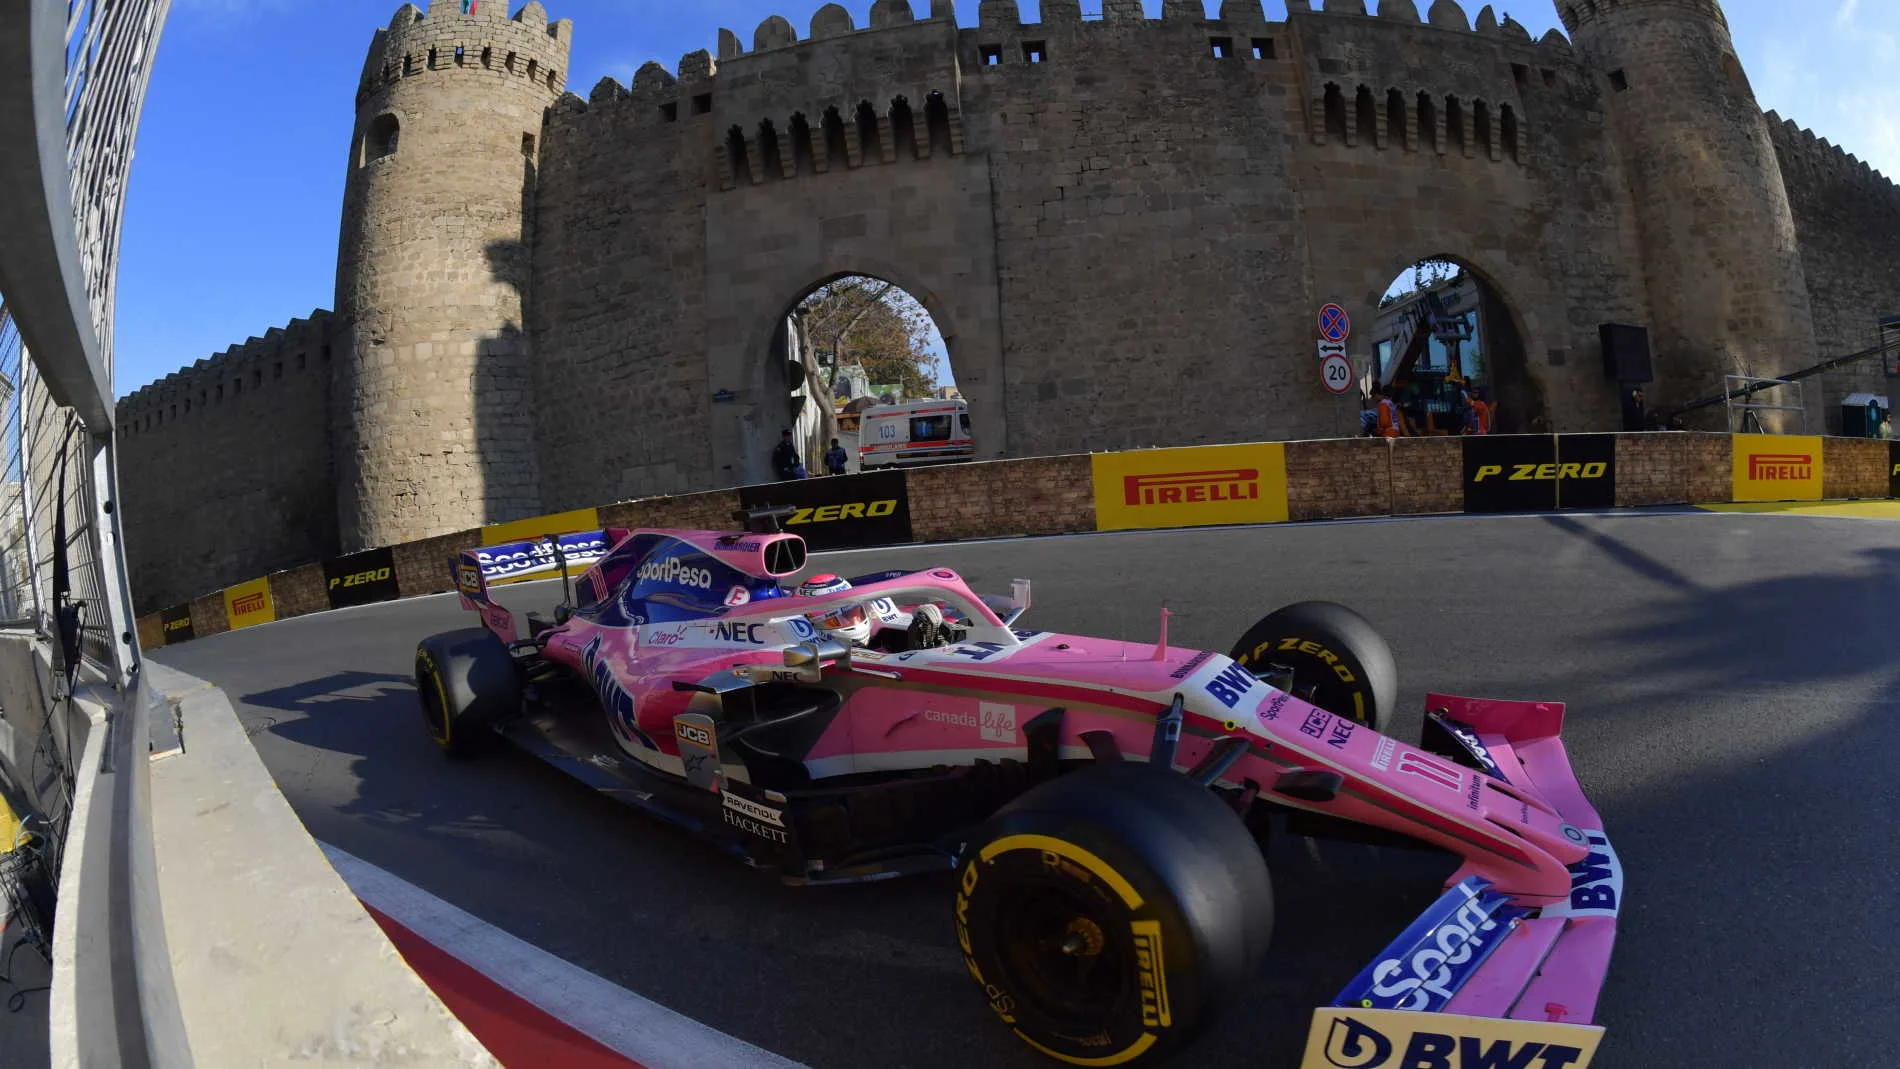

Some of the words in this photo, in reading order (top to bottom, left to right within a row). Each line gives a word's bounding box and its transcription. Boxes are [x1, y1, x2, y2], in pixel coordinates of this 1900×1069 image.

[1329, 365, 1347, 381] 20
[880, 425, 895, 438] 103
[1473, 465, 1503, 482] P
[1508, 462, 1607, 480] ZERO
[1749, 454, 1811, 480] PIRELLI
[1124, 469, 1259, 505] PIRELLI
[785, 500, 897, 525] ZERO
[329, 578, 340, 590] P
[344, 567, 390, 587] ZERO
[232, 592, 264, 616] PIRELLI
[169, 618, 190, 630] ZERO
[715, 621, 764, 644] NEC
[649, 631, 678, 646] Claro
[1278, 638, 1355, 682] ZERO
[772, 670, 800, 681] NEC
[1205, 661, 1258, 709] BWT
[679, 726, 710, 745] JCB
[925, 710, 977, 727] canada
[979, 711, 1016, 737] life
[1327, 719, 1355, 749] NEC
[1397, 750, 1464, 793] 11
[726, 797, 777, 821] RAVENOL
[723, 809, 788, 844] HACKETT
[1570, 836, 1616, 910] BWT
[1372, 878, 1497, 1012] Sport
[1130, 920, 1171, 1027] PIRELLI
